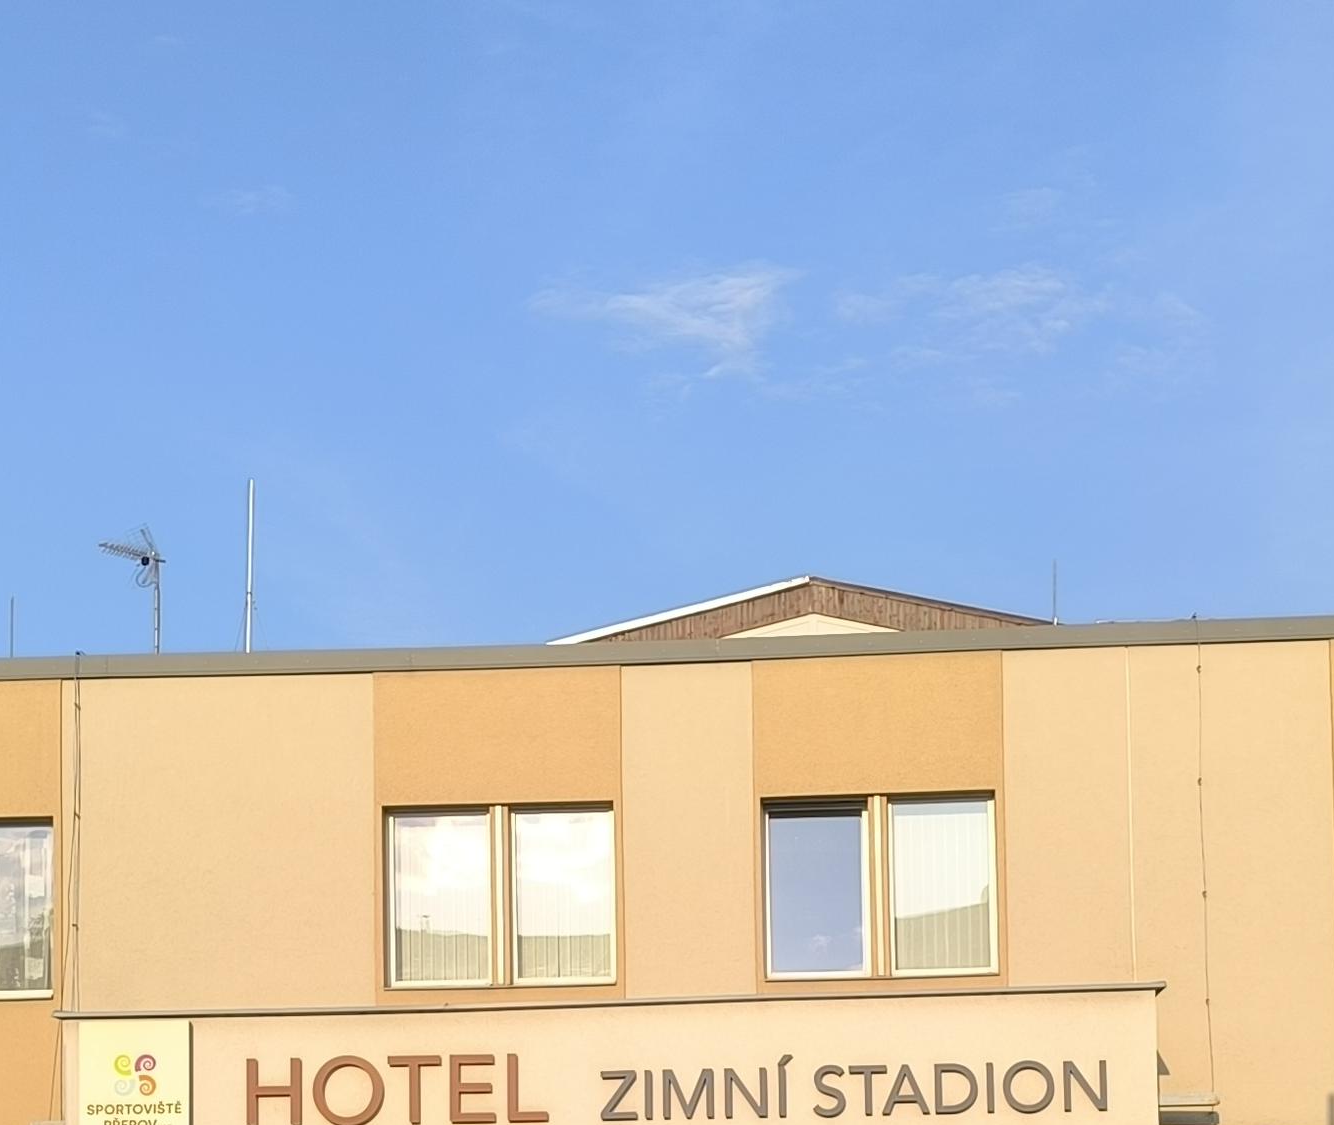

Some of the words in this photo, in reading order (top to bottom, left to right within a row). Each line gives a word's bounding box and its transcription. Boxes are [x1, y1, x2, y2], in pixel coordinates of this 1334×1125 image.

[87, 1101, 182, 1115] SPORTOVIŠTĚ
[600, 1054, 793, 1122] ZIMNÍ
[813, 1059, 1108, 1118] STADION
